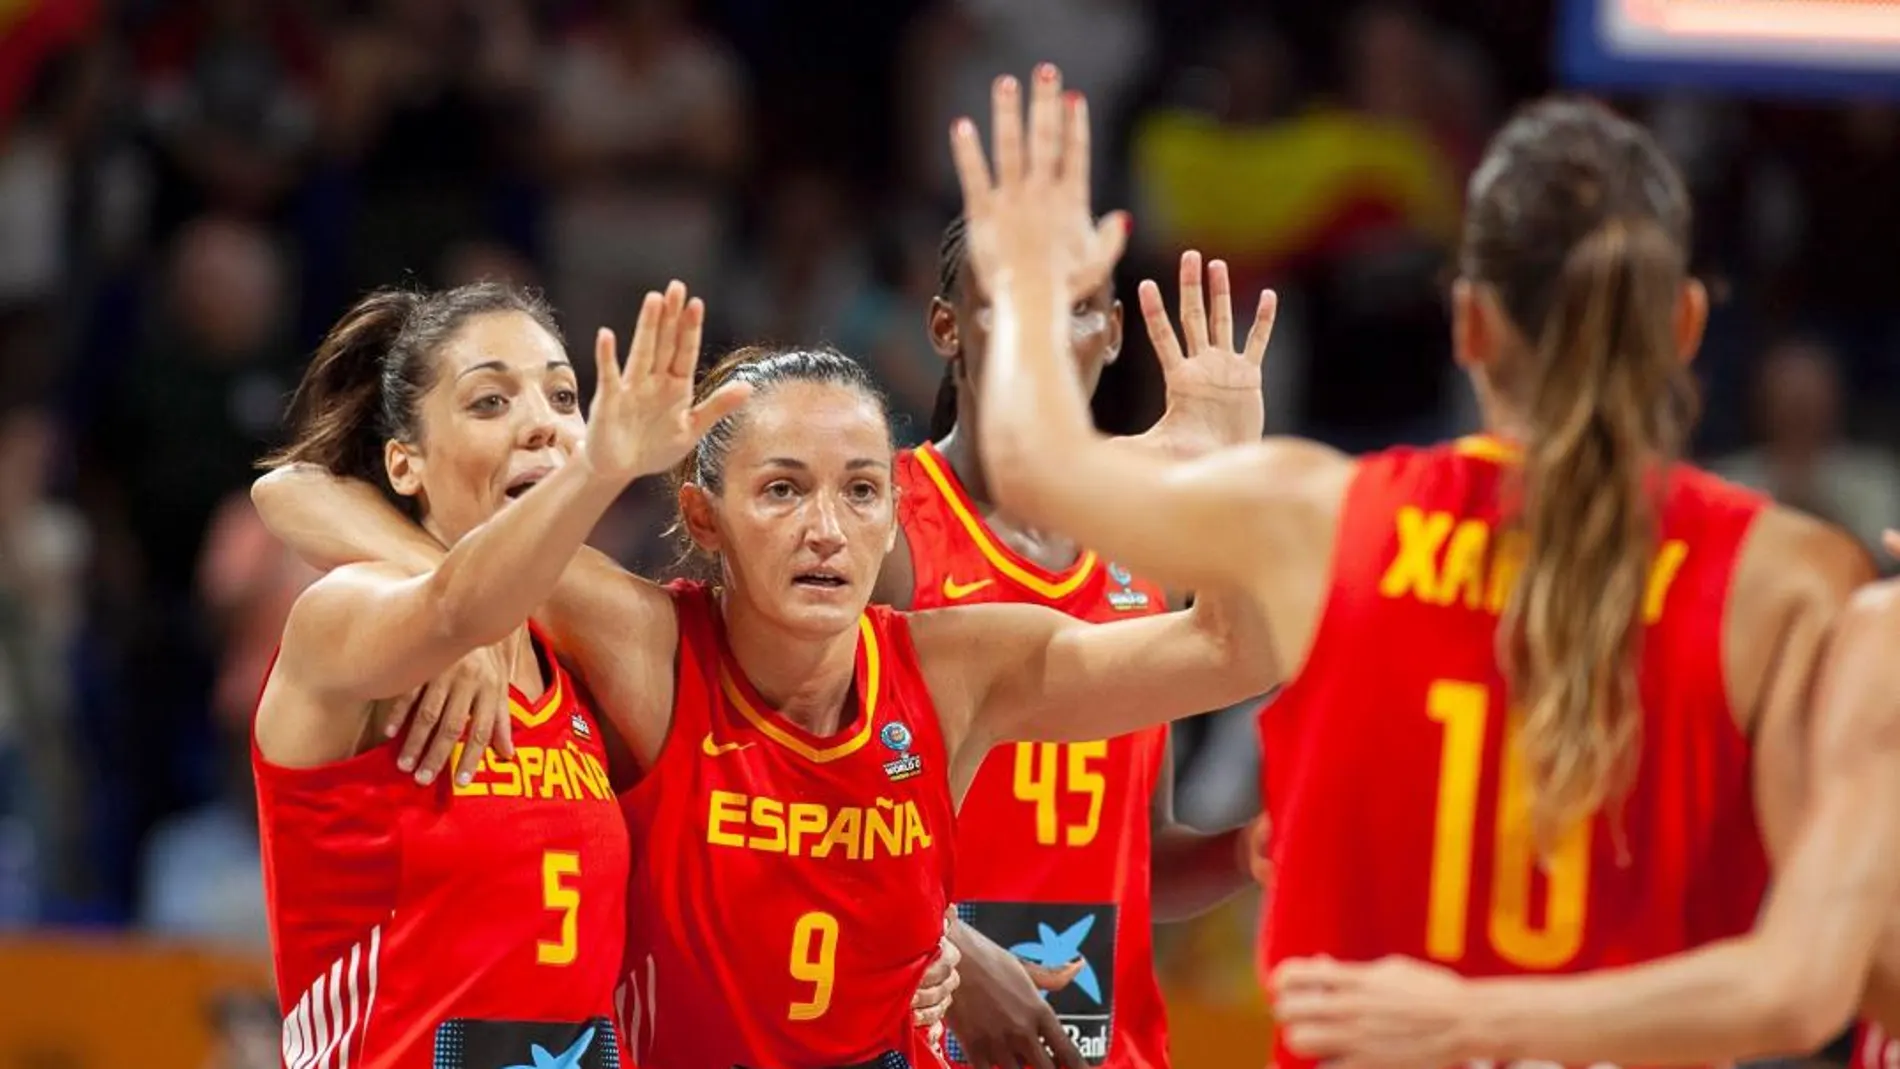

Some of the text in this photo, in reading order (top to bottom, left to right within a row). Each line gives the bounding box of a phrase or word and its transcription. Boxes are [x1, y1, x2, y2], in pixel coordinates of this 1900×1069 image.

[1381, 505, 1688, 625] XAY
[707, 790, 932, 861] ESPAÑA
[1013, 741, 1107, 847] 45
[537, 851, 580, 966] 5
[788, 911, 839, 1020] 9
